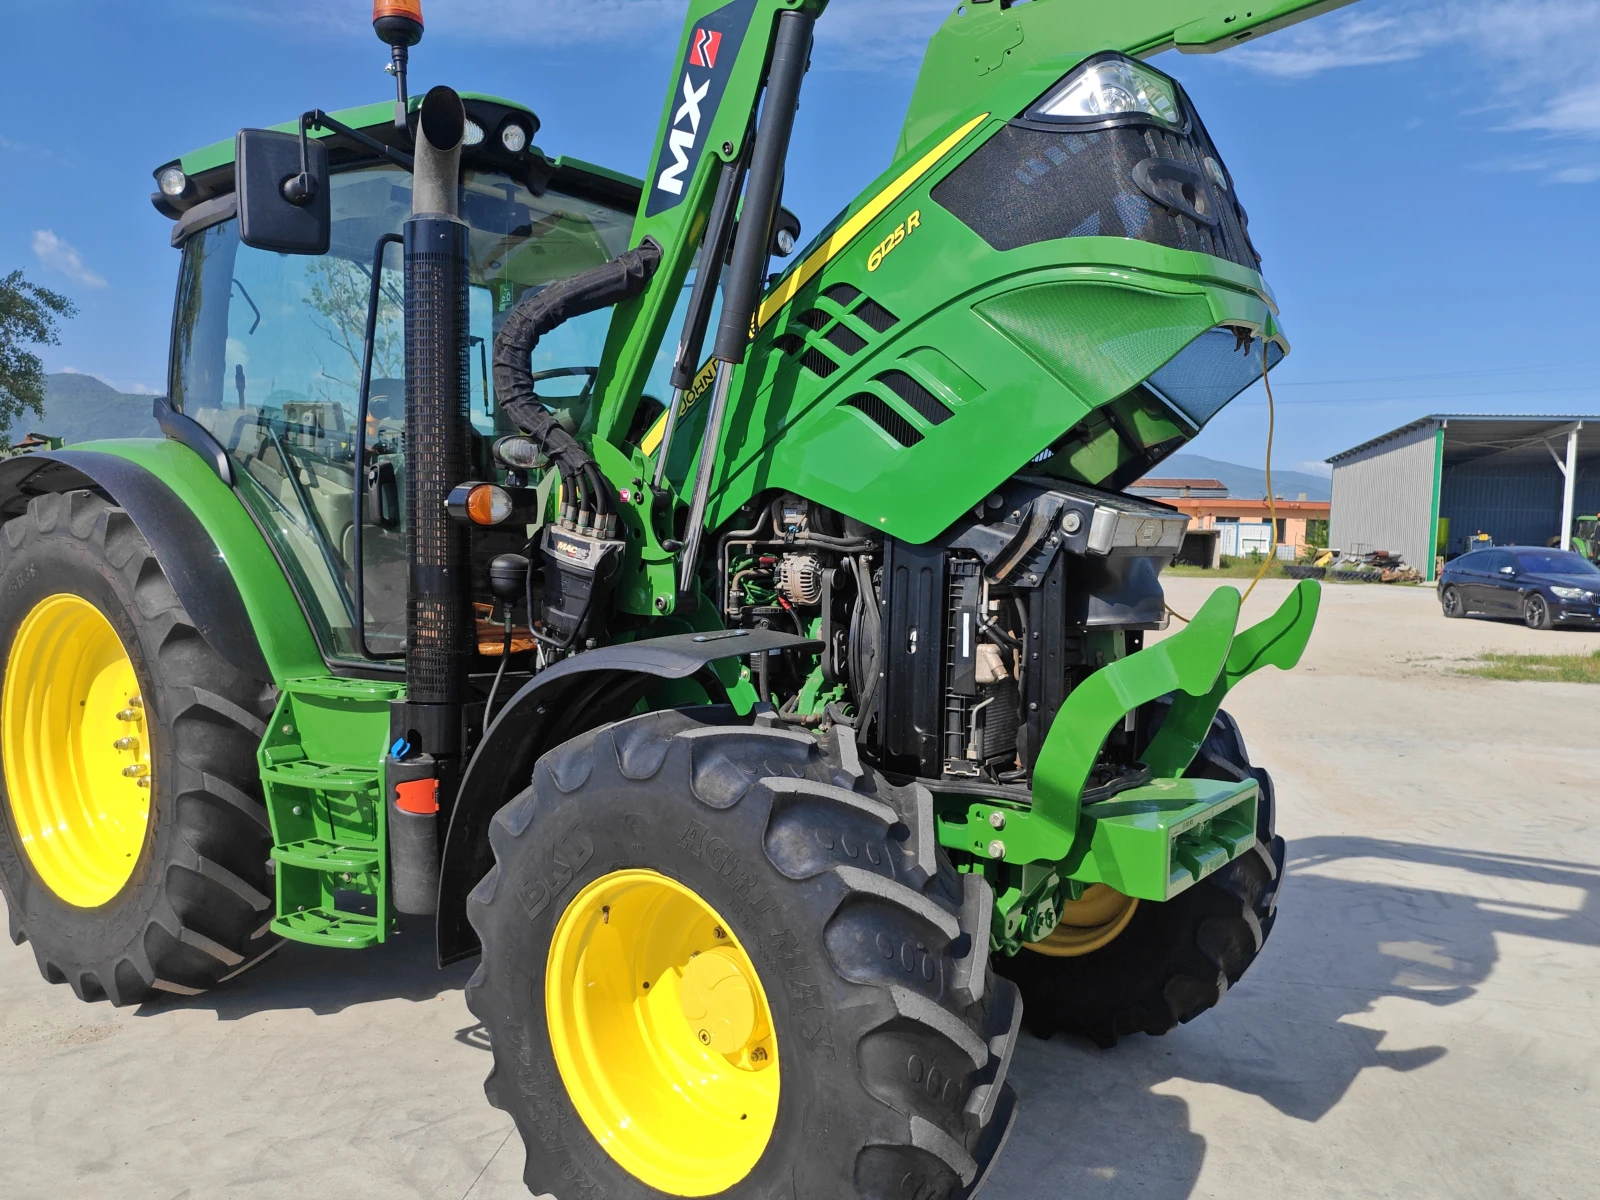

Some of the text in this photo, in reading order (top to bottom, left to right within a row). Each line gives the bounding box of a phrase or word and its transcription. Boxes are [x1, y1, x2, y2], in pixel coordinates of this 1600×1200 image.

[657, 72, 711, 195] MX
[681, 369, 714, 413] JOHN
[518, 822, 594, 922] BKT
